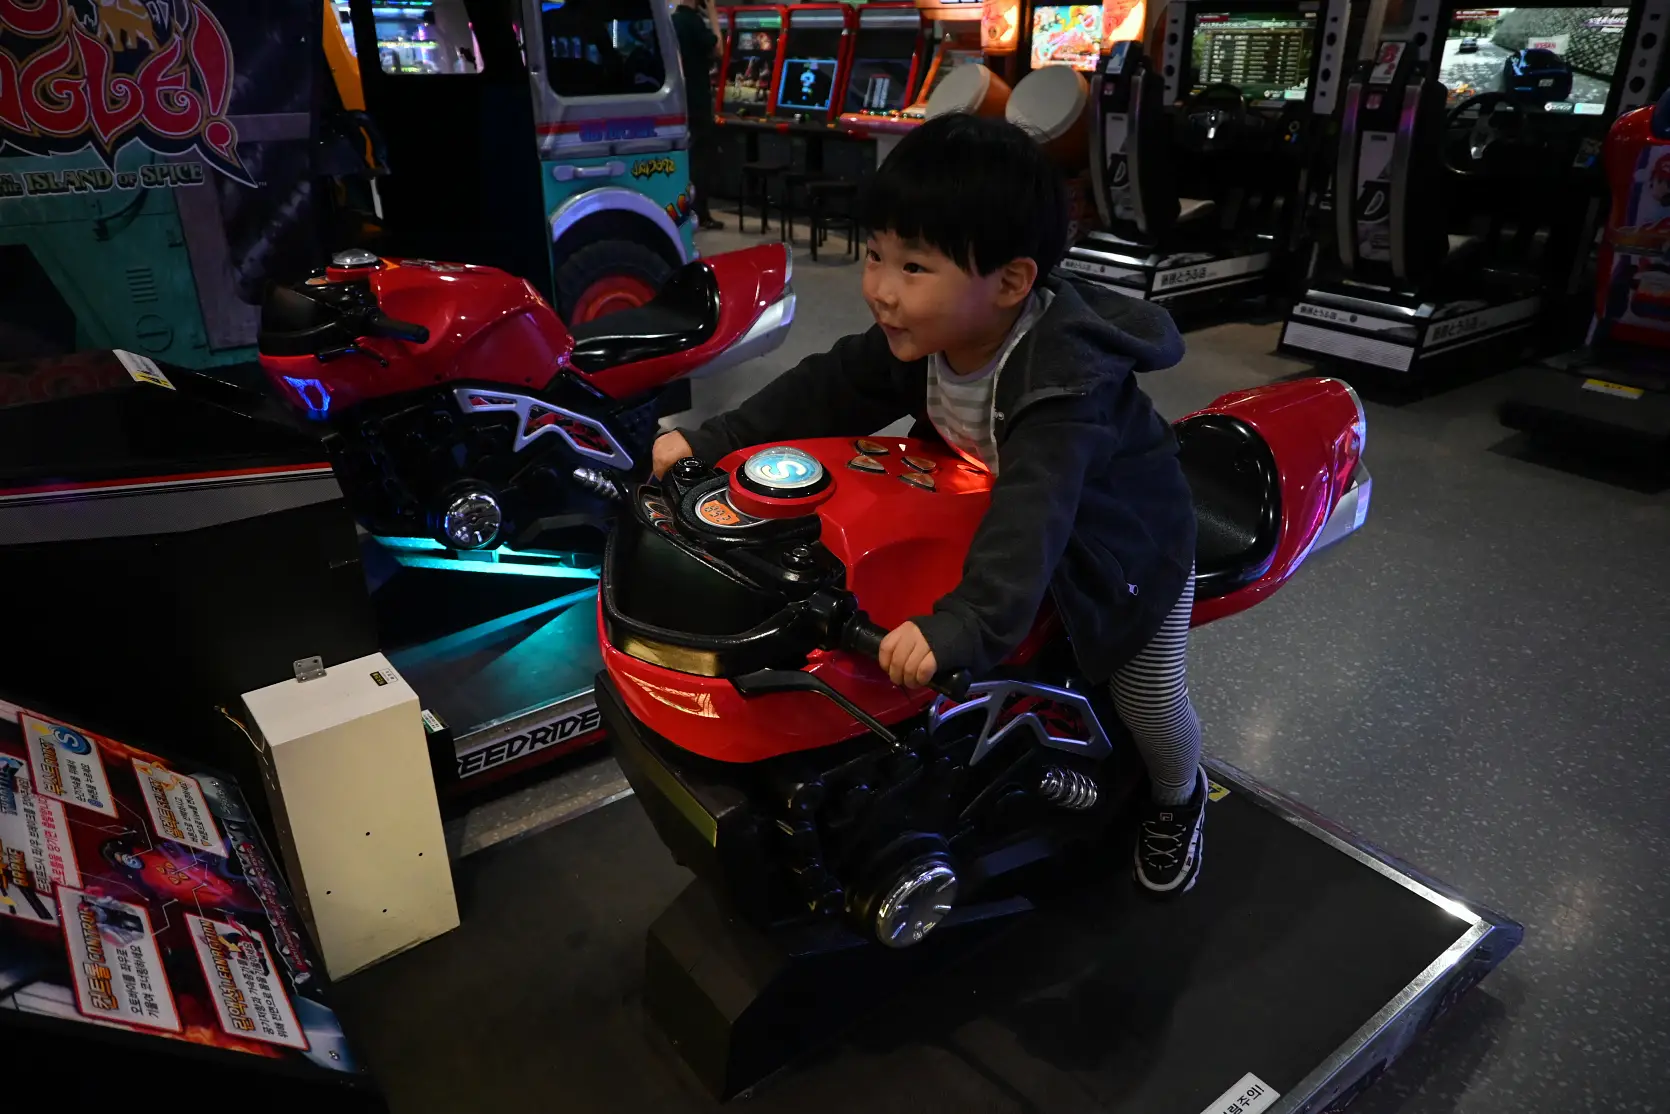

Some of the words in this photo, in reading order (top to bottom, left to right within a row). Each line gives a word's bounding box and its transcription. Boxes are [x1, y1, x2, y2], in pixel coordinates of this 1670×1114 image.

[24, 168, 114, 196] ISLAND
[116, 172, 138, 190] OF
[139, 162, 204, 188] SPICE
[455, 708, 601, 776] EEDRIDE
[116, 948, 132, 972] 좌우로
[213, 956, 236, 987] LEAN
[82, 962, 119, 1010] 컨트롤
[122, 973, 144, 1016] 오토바이를
[219, 986, 256, 1031] 린액션
[1222, 1084, 1265, 1114] 림주의!
